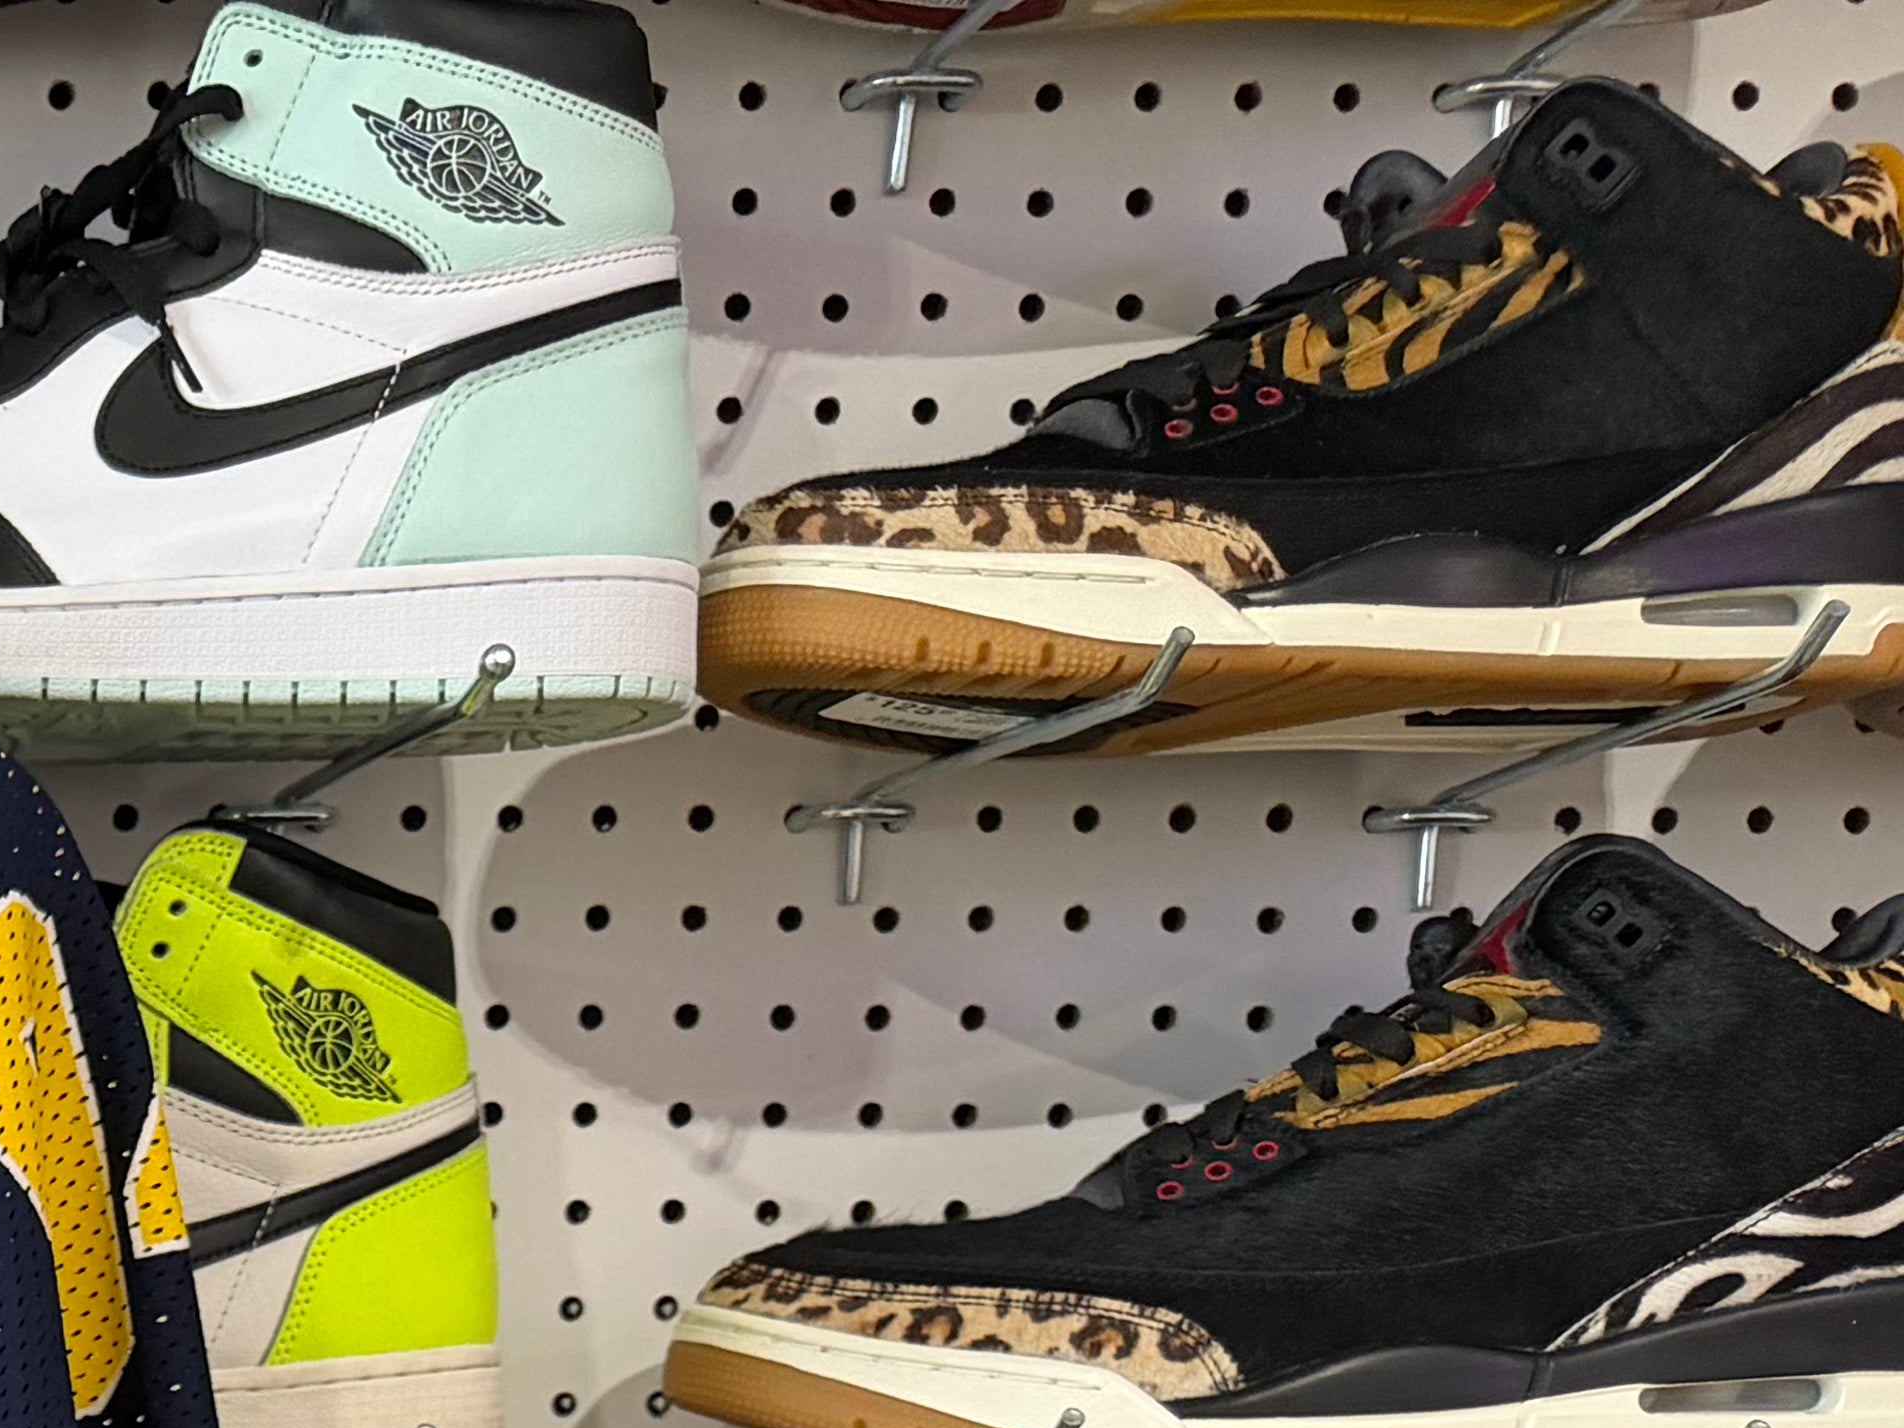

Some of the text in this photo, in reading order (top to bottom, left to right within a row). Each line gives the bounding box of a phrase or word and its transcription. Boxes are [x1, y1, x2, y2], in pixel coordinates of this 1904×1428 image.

[405, 107, 452, 133] AIR
[459, 107, 533, 190] JORDAN
[293, 986, 387, 1071] AIR JORDAN
